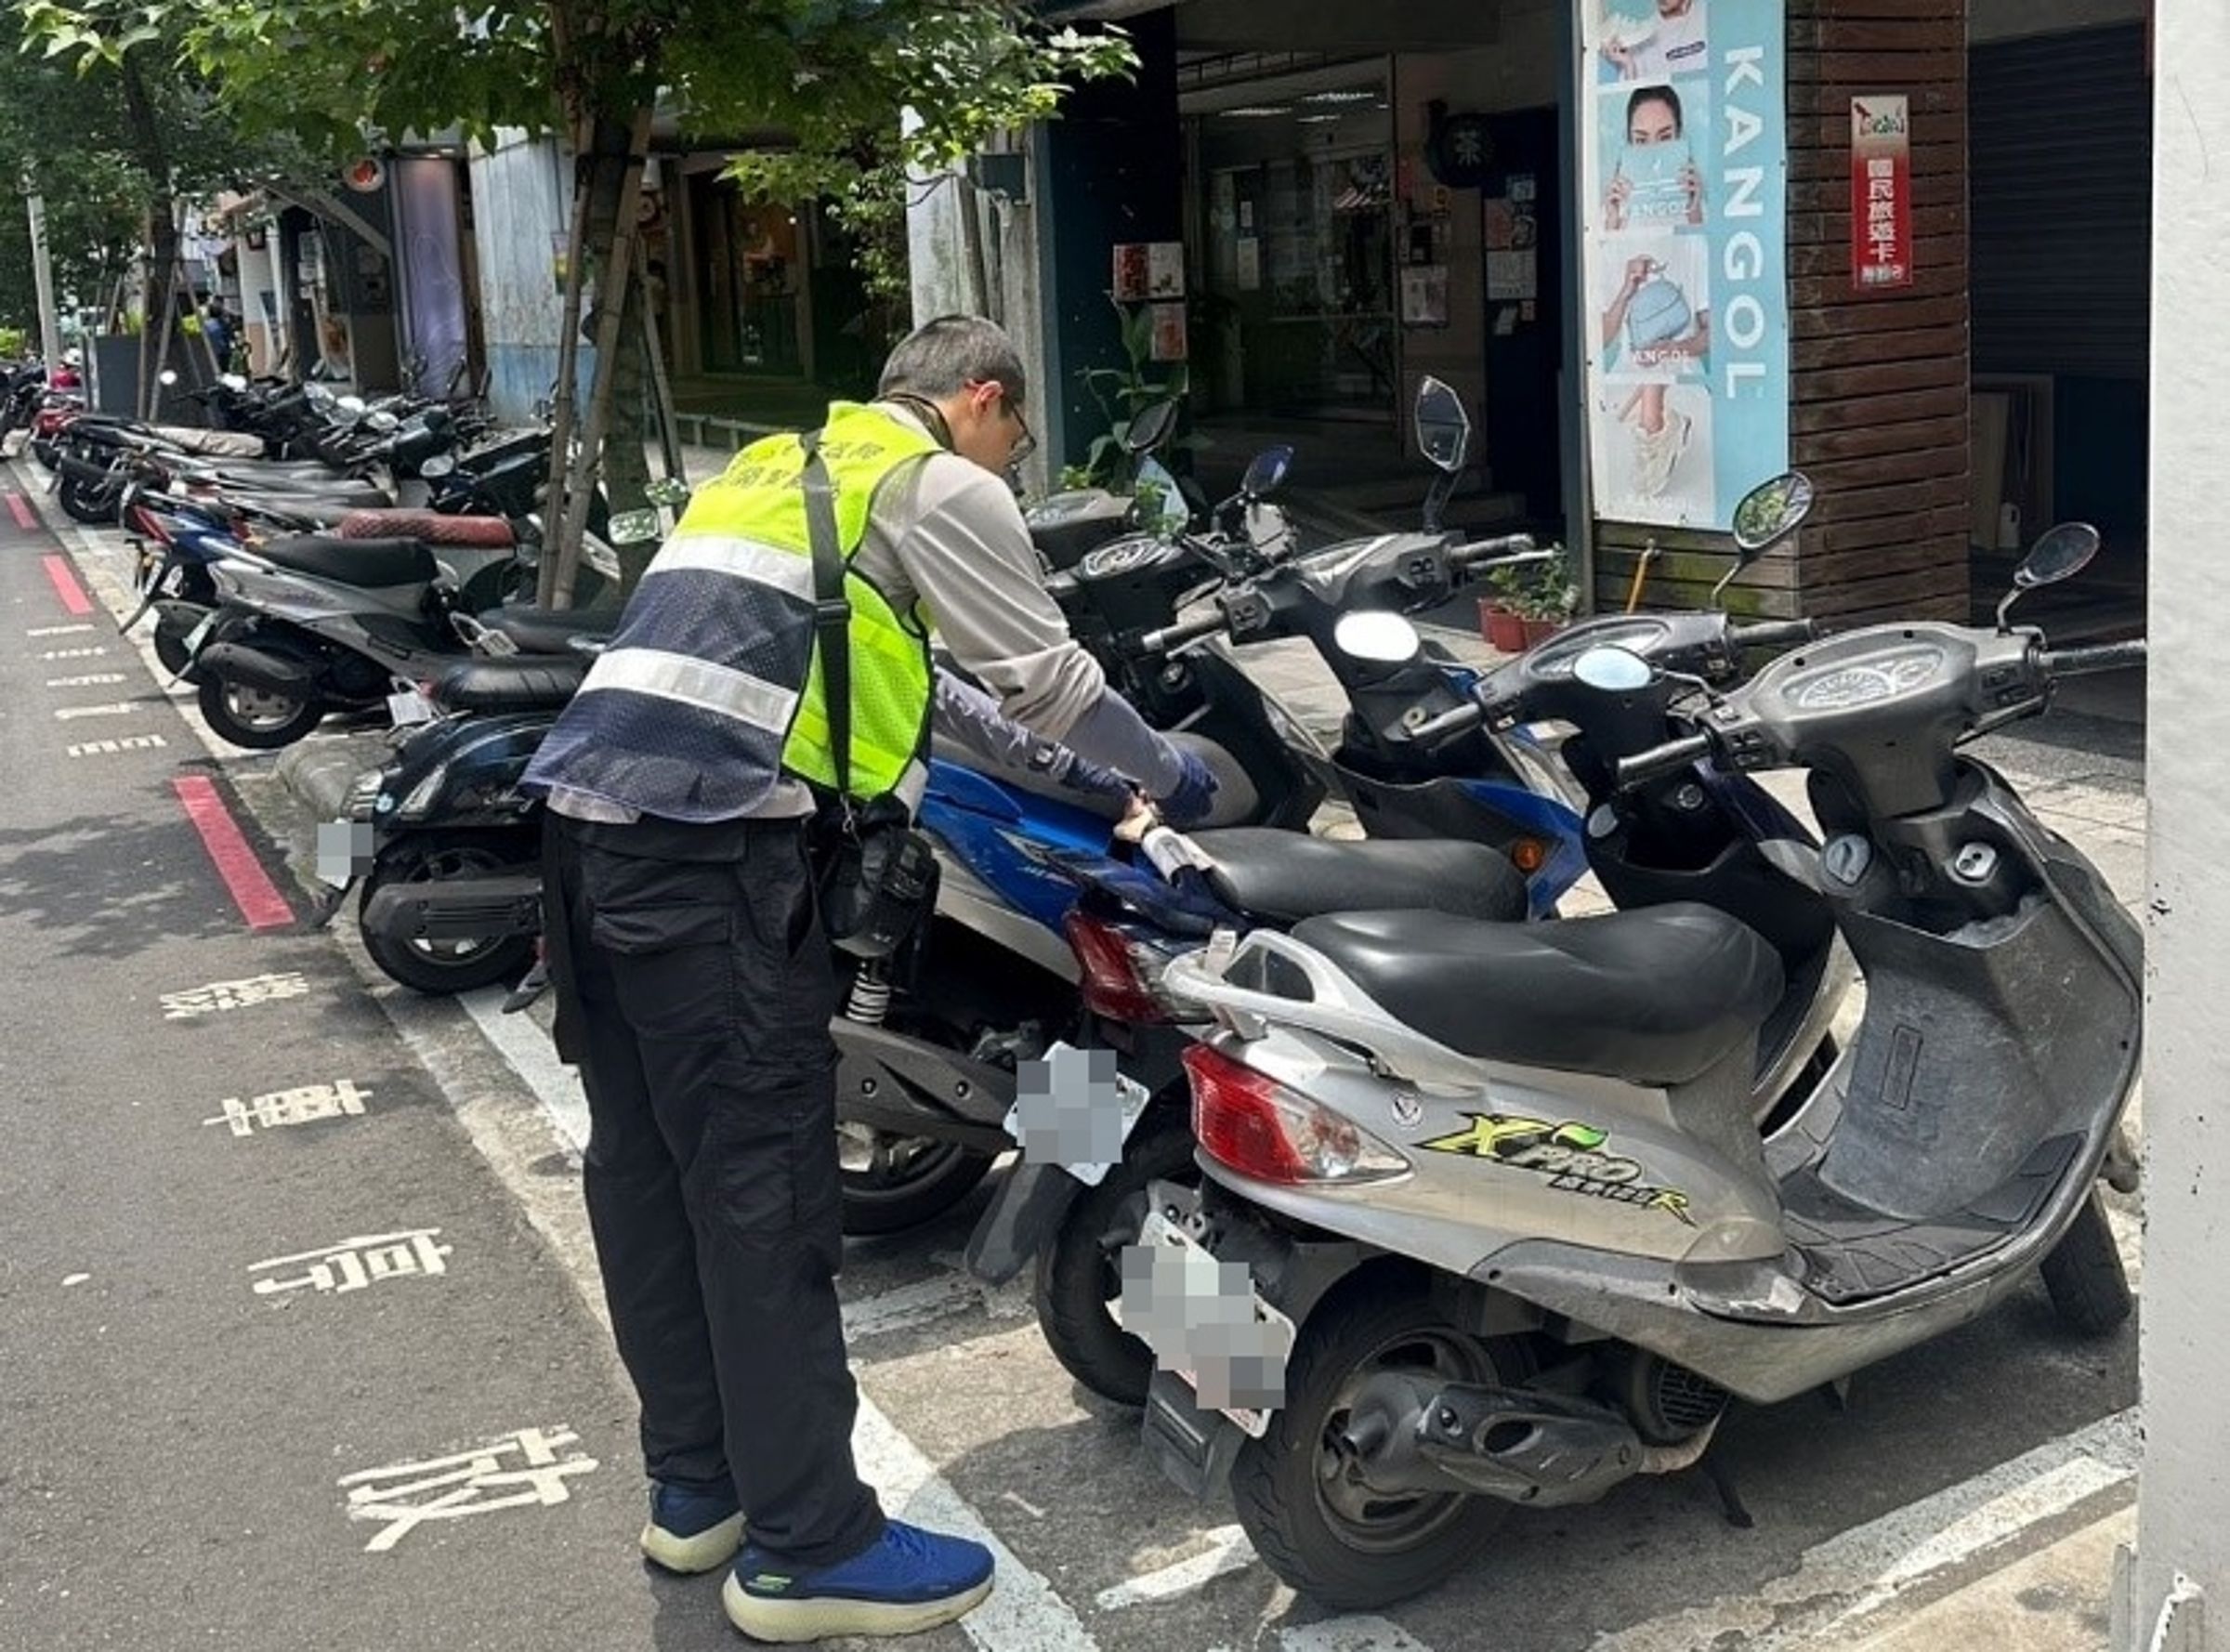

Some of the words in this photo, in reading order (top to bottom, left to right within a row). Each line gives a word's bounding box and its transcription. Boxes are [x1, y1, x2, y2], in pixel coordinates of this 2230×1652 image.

[1453, 130, 1483, 167] 茶
[1724, 45, 1764, 400] KANGOL
[1622, 348, 1692, 364] ANGOL
